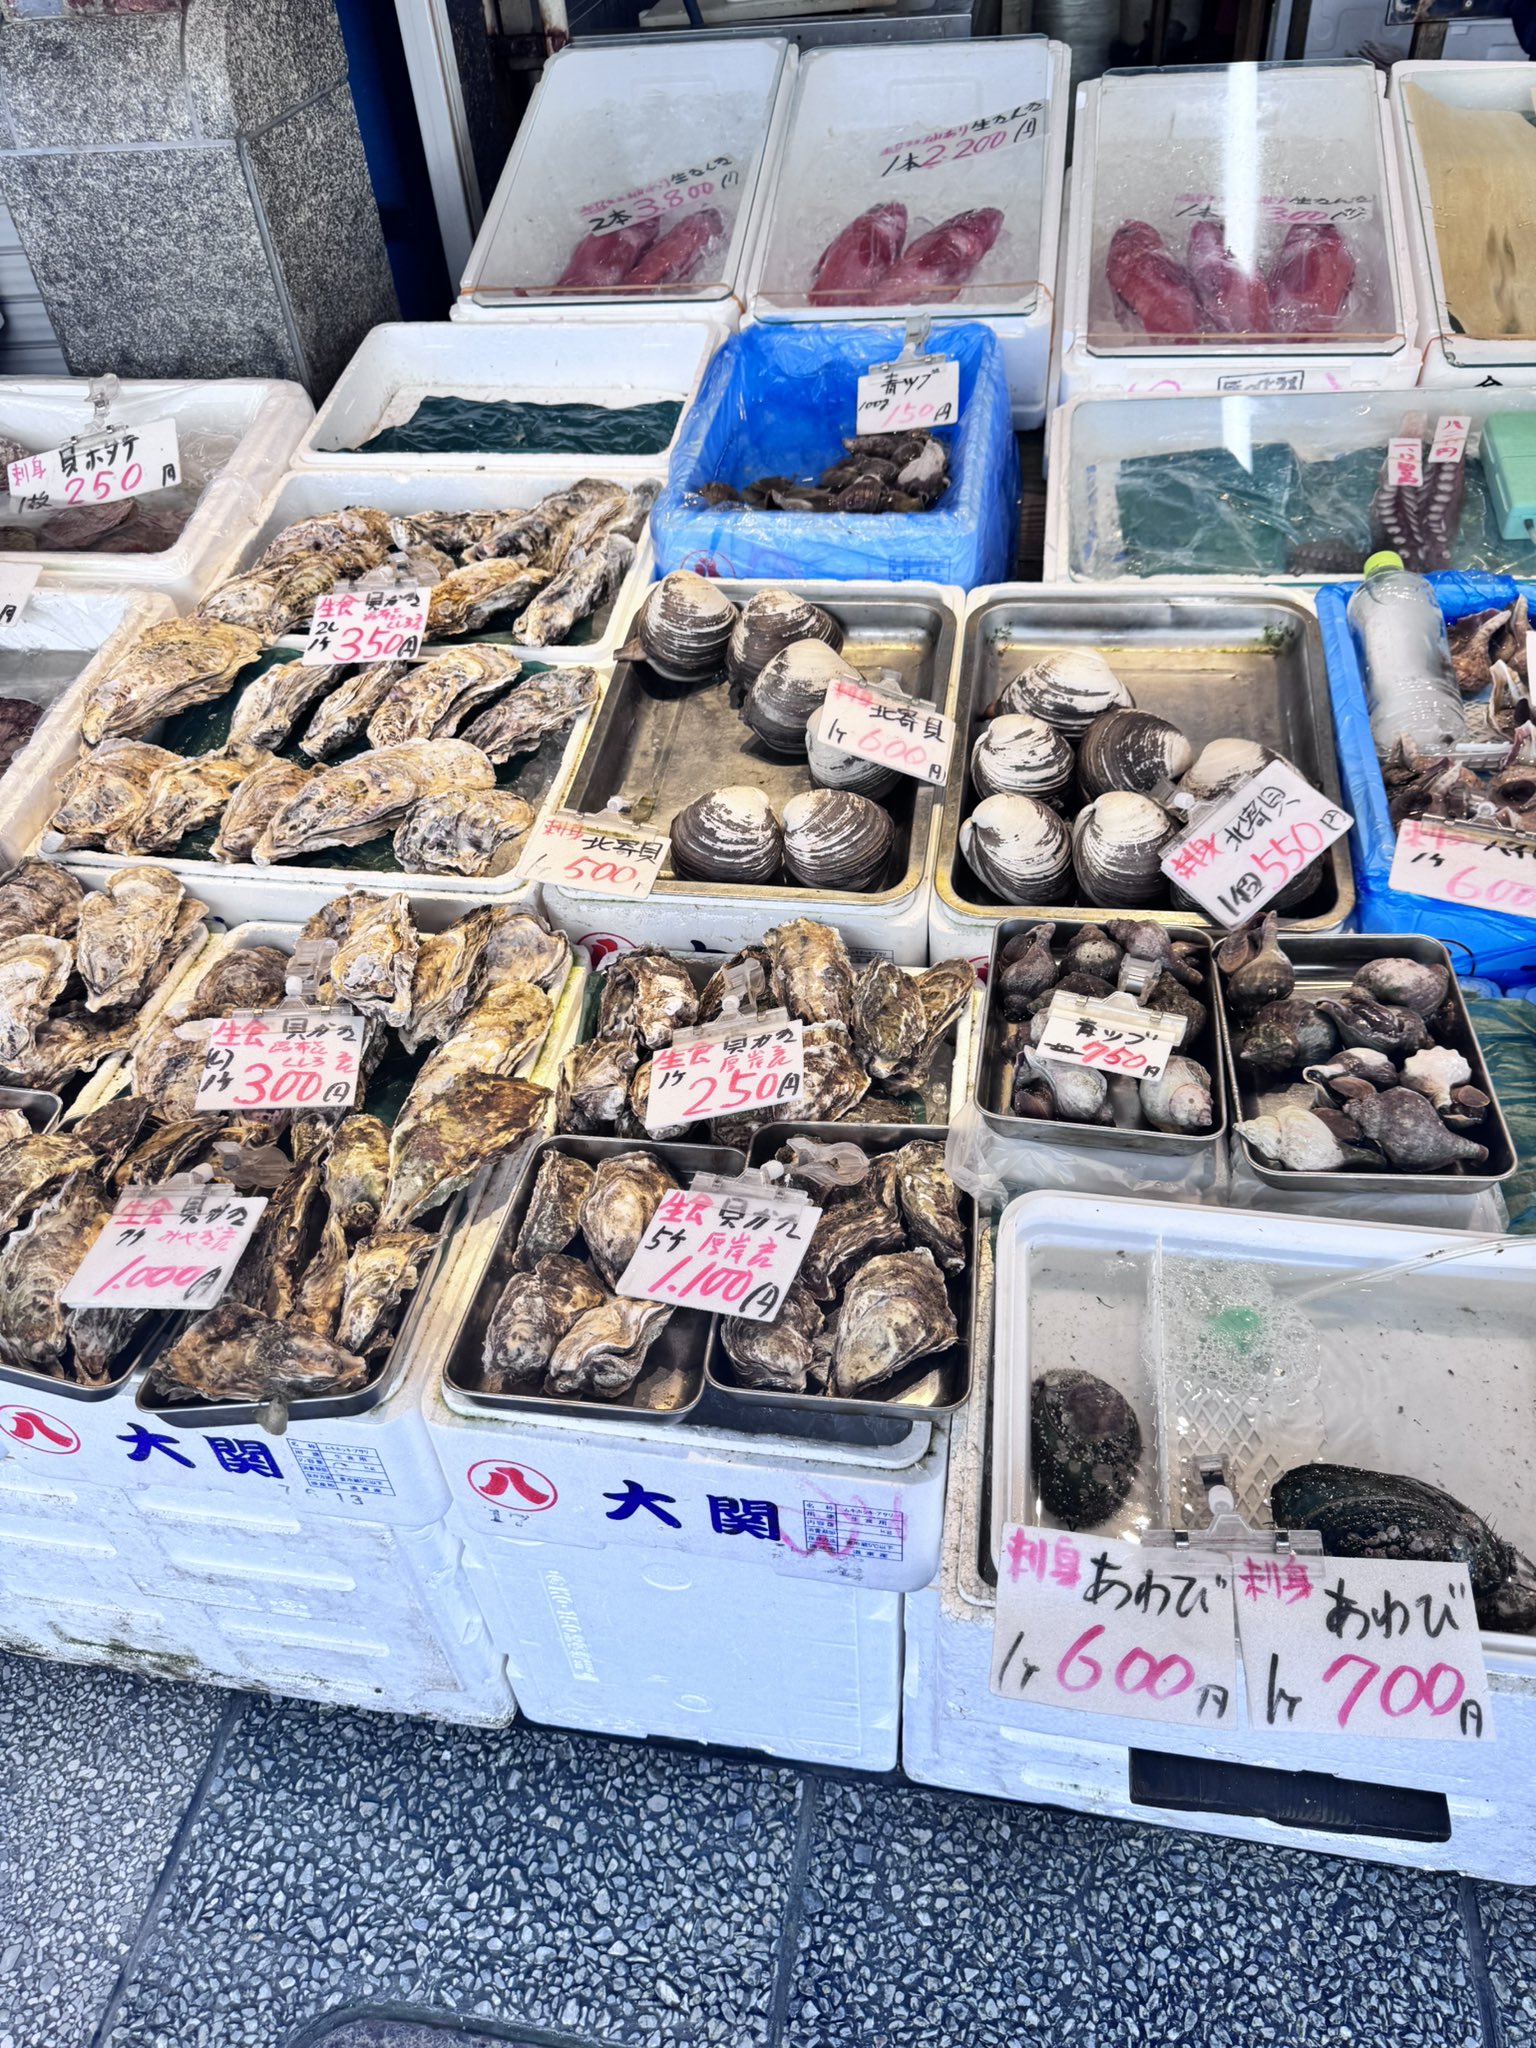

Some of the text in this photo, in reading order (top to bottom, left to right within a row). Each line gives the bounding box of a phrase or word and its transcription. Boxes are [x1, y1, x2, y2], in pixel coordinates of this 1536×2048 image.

[116, 1422, 284, 1479] 大関
[603, 1480, 781, 1541] 大関
[1008, 1528, 1227, 1618] 刺身 あわび
[1239, 1554, 1466, 1640] 刺身 あわび
